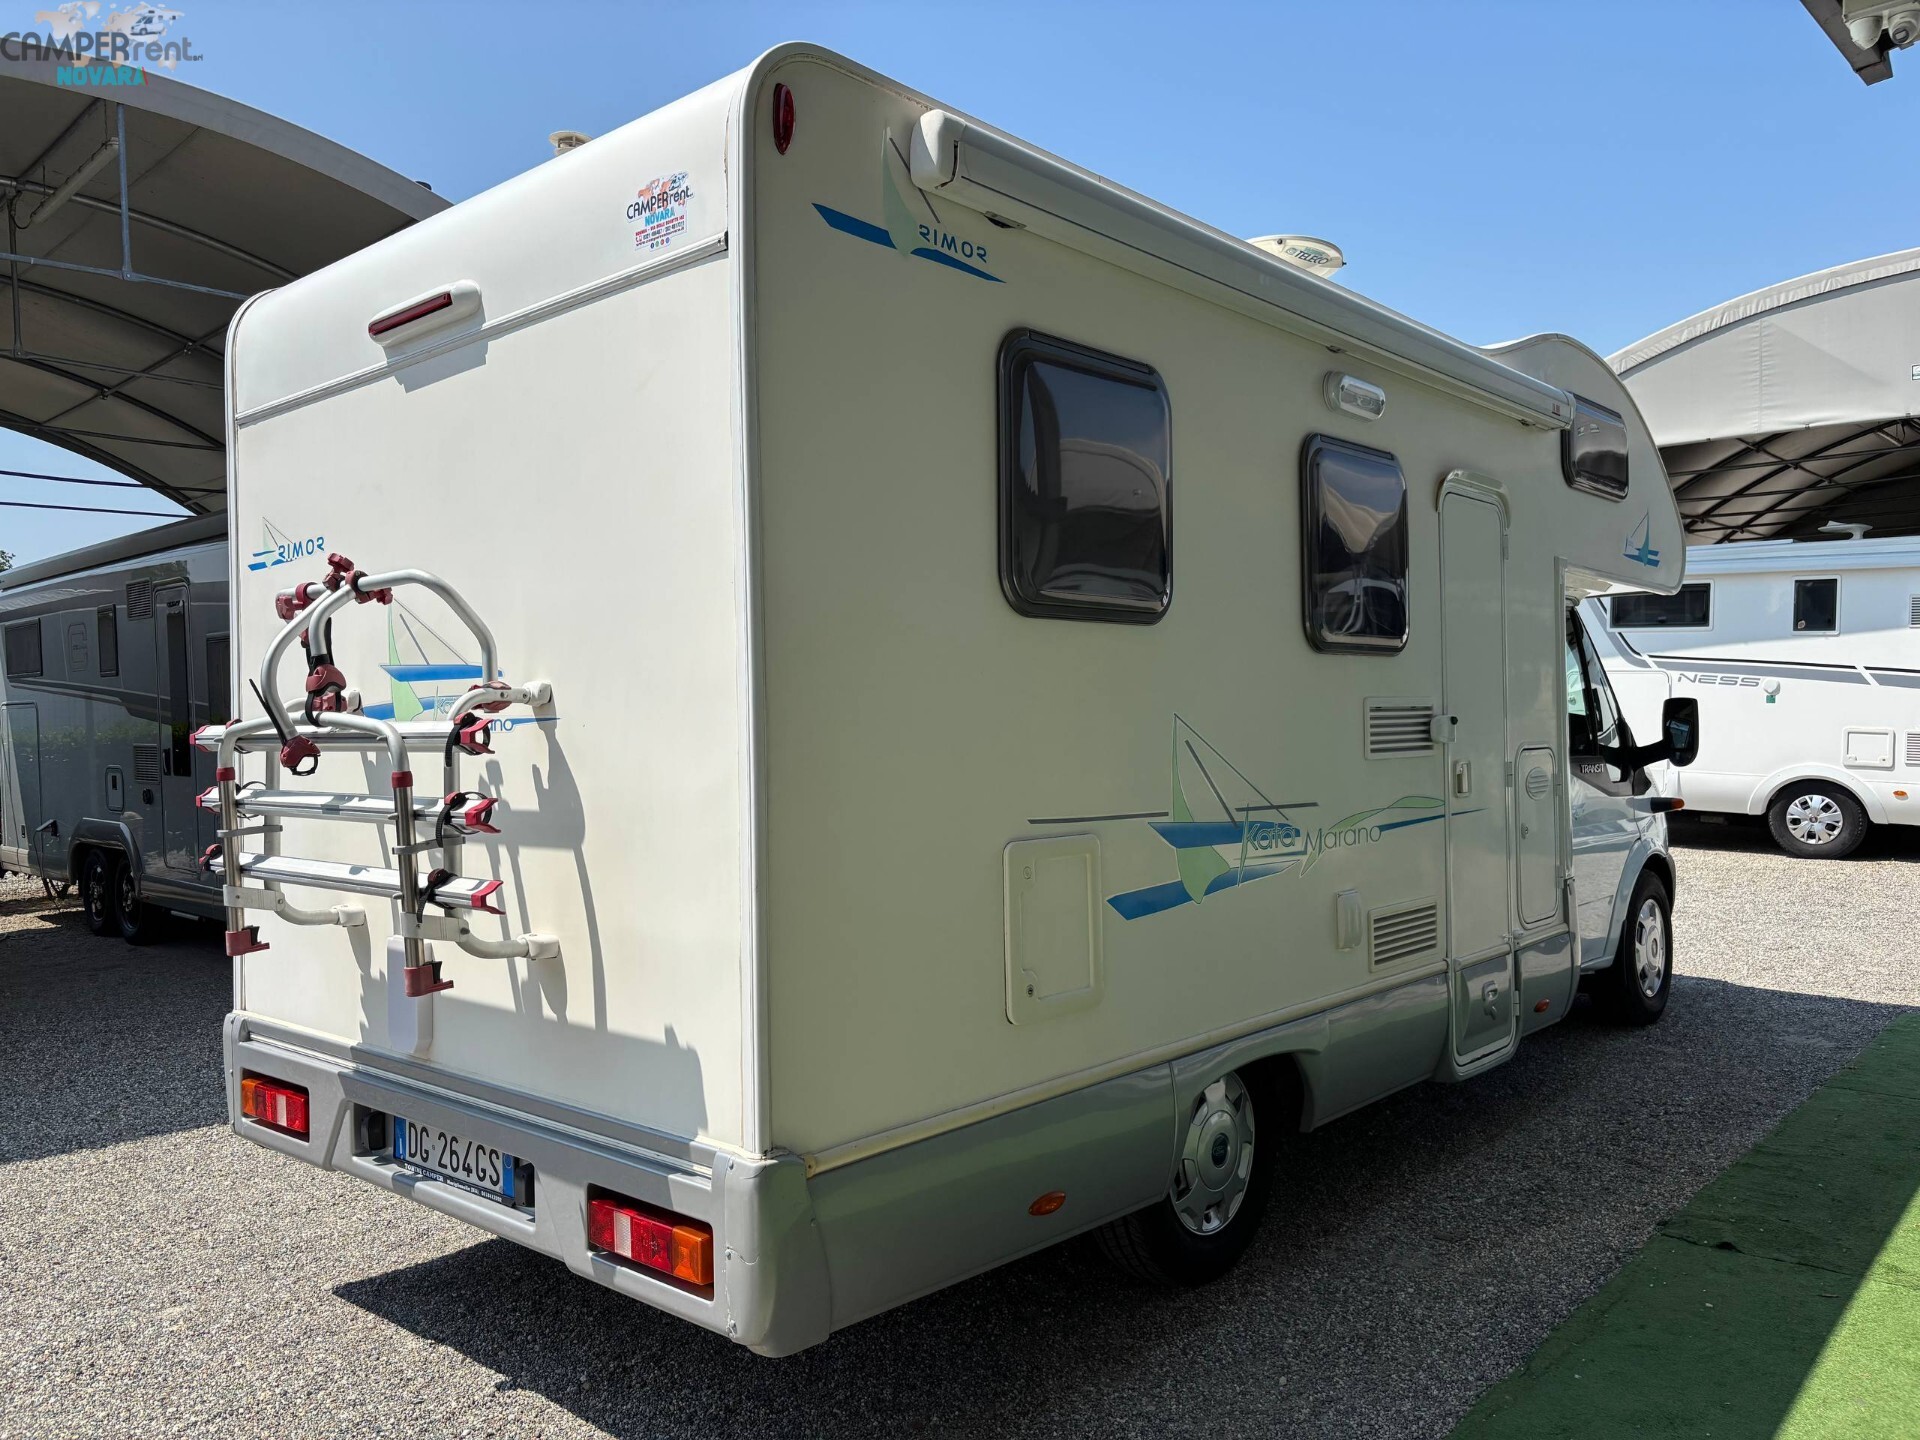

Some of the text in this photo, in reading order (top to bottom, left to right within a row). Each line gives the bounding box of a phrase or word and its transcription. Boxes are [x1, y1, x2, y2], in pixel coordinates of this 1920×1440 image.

[645, 207, 675, 226] NOVARA
[919, 224, 987, 263] RIMOR
[1295, 250, 1329, 264] TELECO
[278, 536, 324, 559] RIMOR
[1678, 673, 1761, 687] NESS
[1581, 764, 1604, 773] TRANSIT
[1246, 823, 1382, 857] Kata Marano
[408, 1121, 500, 1187] DG 264GS
[423, 1170, 444, 1181] CAMPER
